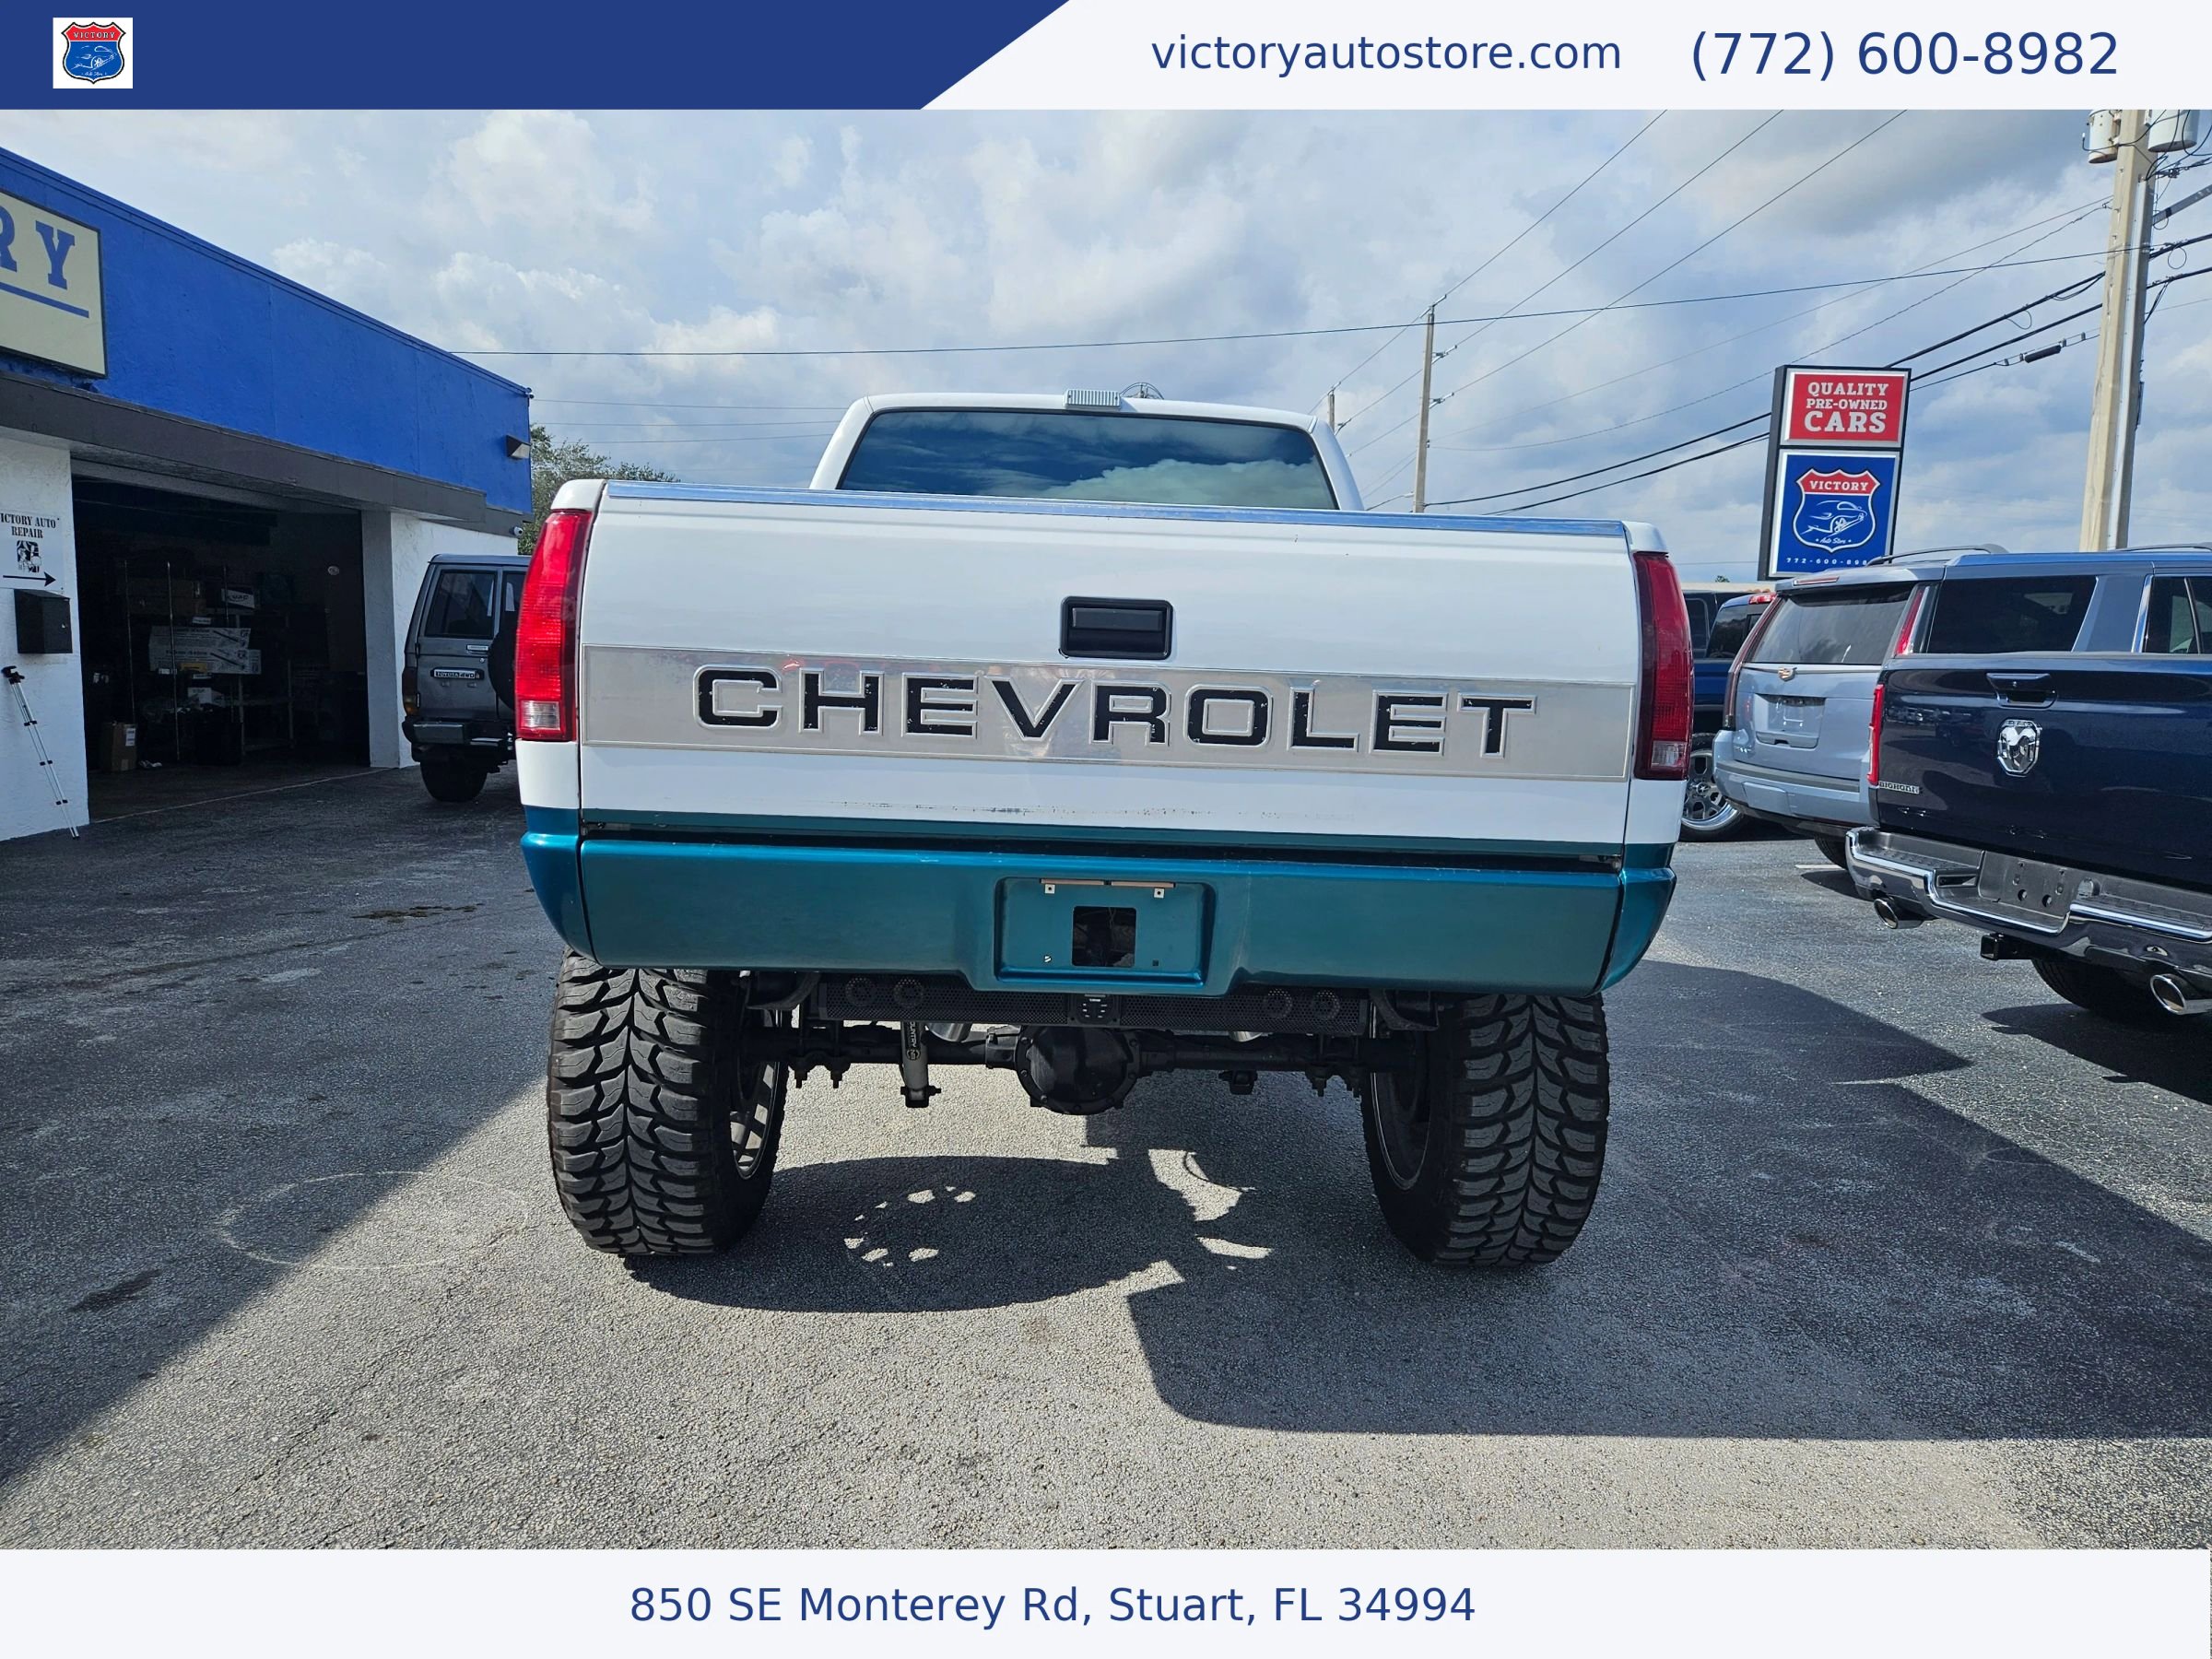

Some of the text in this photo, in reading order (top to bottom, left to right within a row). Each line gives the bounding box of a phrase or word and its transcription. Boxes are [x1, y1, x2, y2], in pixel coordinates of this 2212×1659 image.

[1807, 382, 1889, 396] QUALITY
[1806, 398, 1888, 410] PRE-OWNED
[1804, 411, 1887, 433] CARS
[1809, 479, 1869, 492] VICTORY
[0, 512, 56, 528] ICTORY AUTO
[11, 526, 43, 538] REPAIR
[1786, 557, 1867, 565] 772-600-898
[693, 663, 1538, 759] CHEVROLET
